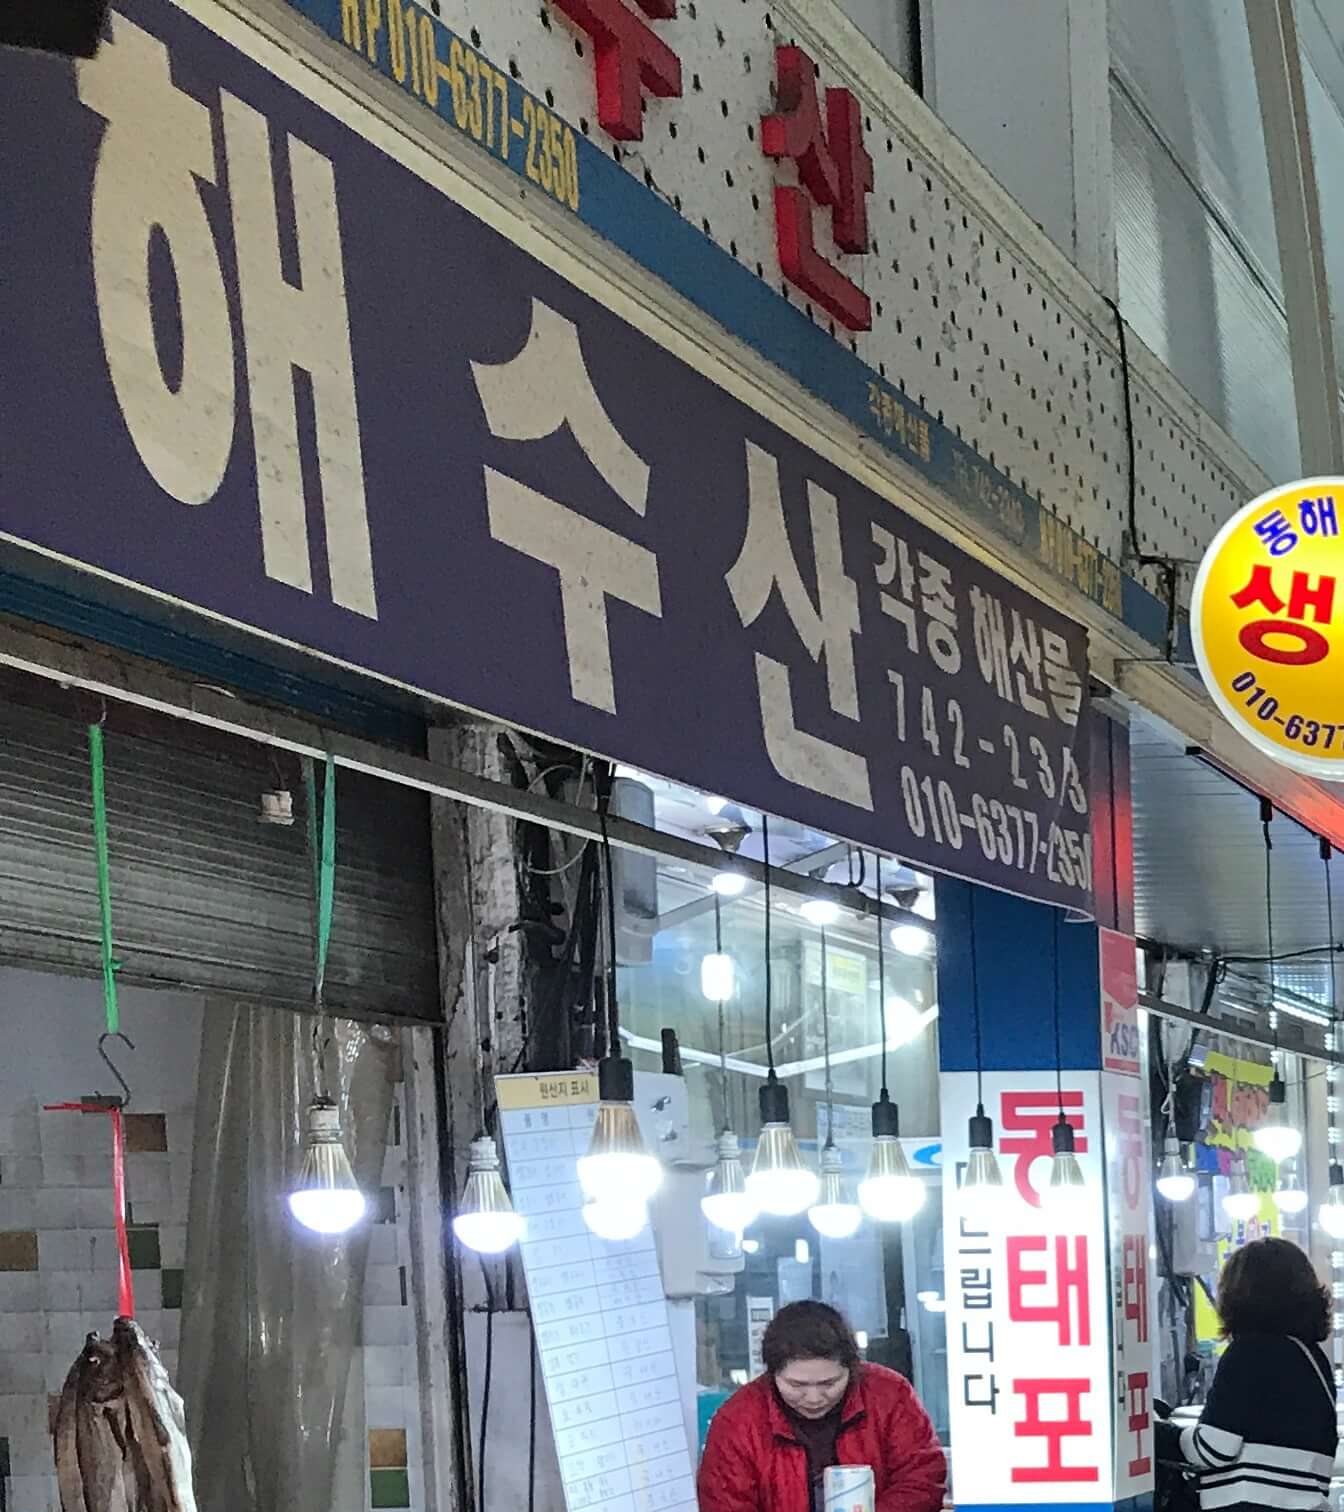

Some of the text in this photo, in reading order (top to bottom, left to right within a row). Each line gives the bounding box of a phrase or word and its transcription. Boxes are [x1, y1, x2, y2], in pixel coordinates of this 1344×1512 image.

[388, 0, 580, 211] 010-6377-2350
[871, 520, 962, 675] 각종
[969, 584, 1083, 727] 해산물
[999, 1089, 1100, 1484] 동태포
